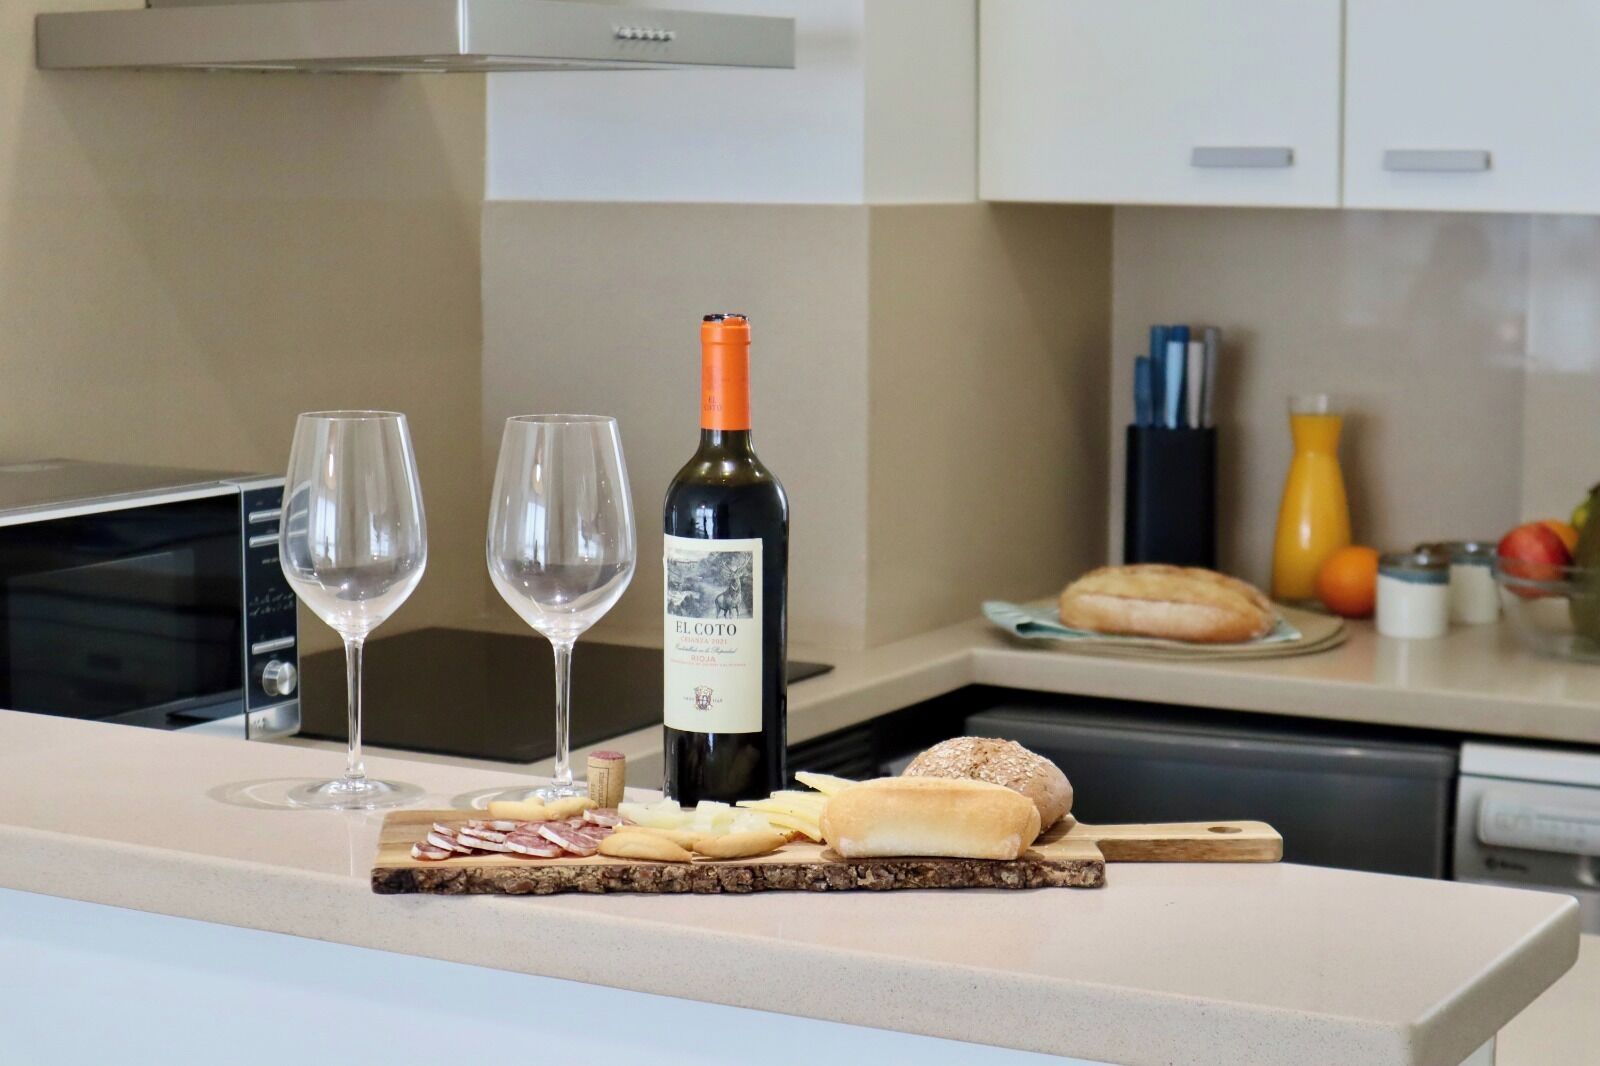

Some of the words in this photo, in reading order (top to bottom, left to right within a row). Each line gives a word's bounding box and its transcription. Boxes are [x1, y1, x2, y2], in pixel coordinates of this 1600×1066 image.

[676, 620, 691, 634] EL
[694, 622, 737, 637] COTO
[690, 655, 716, 663] RIOJA
